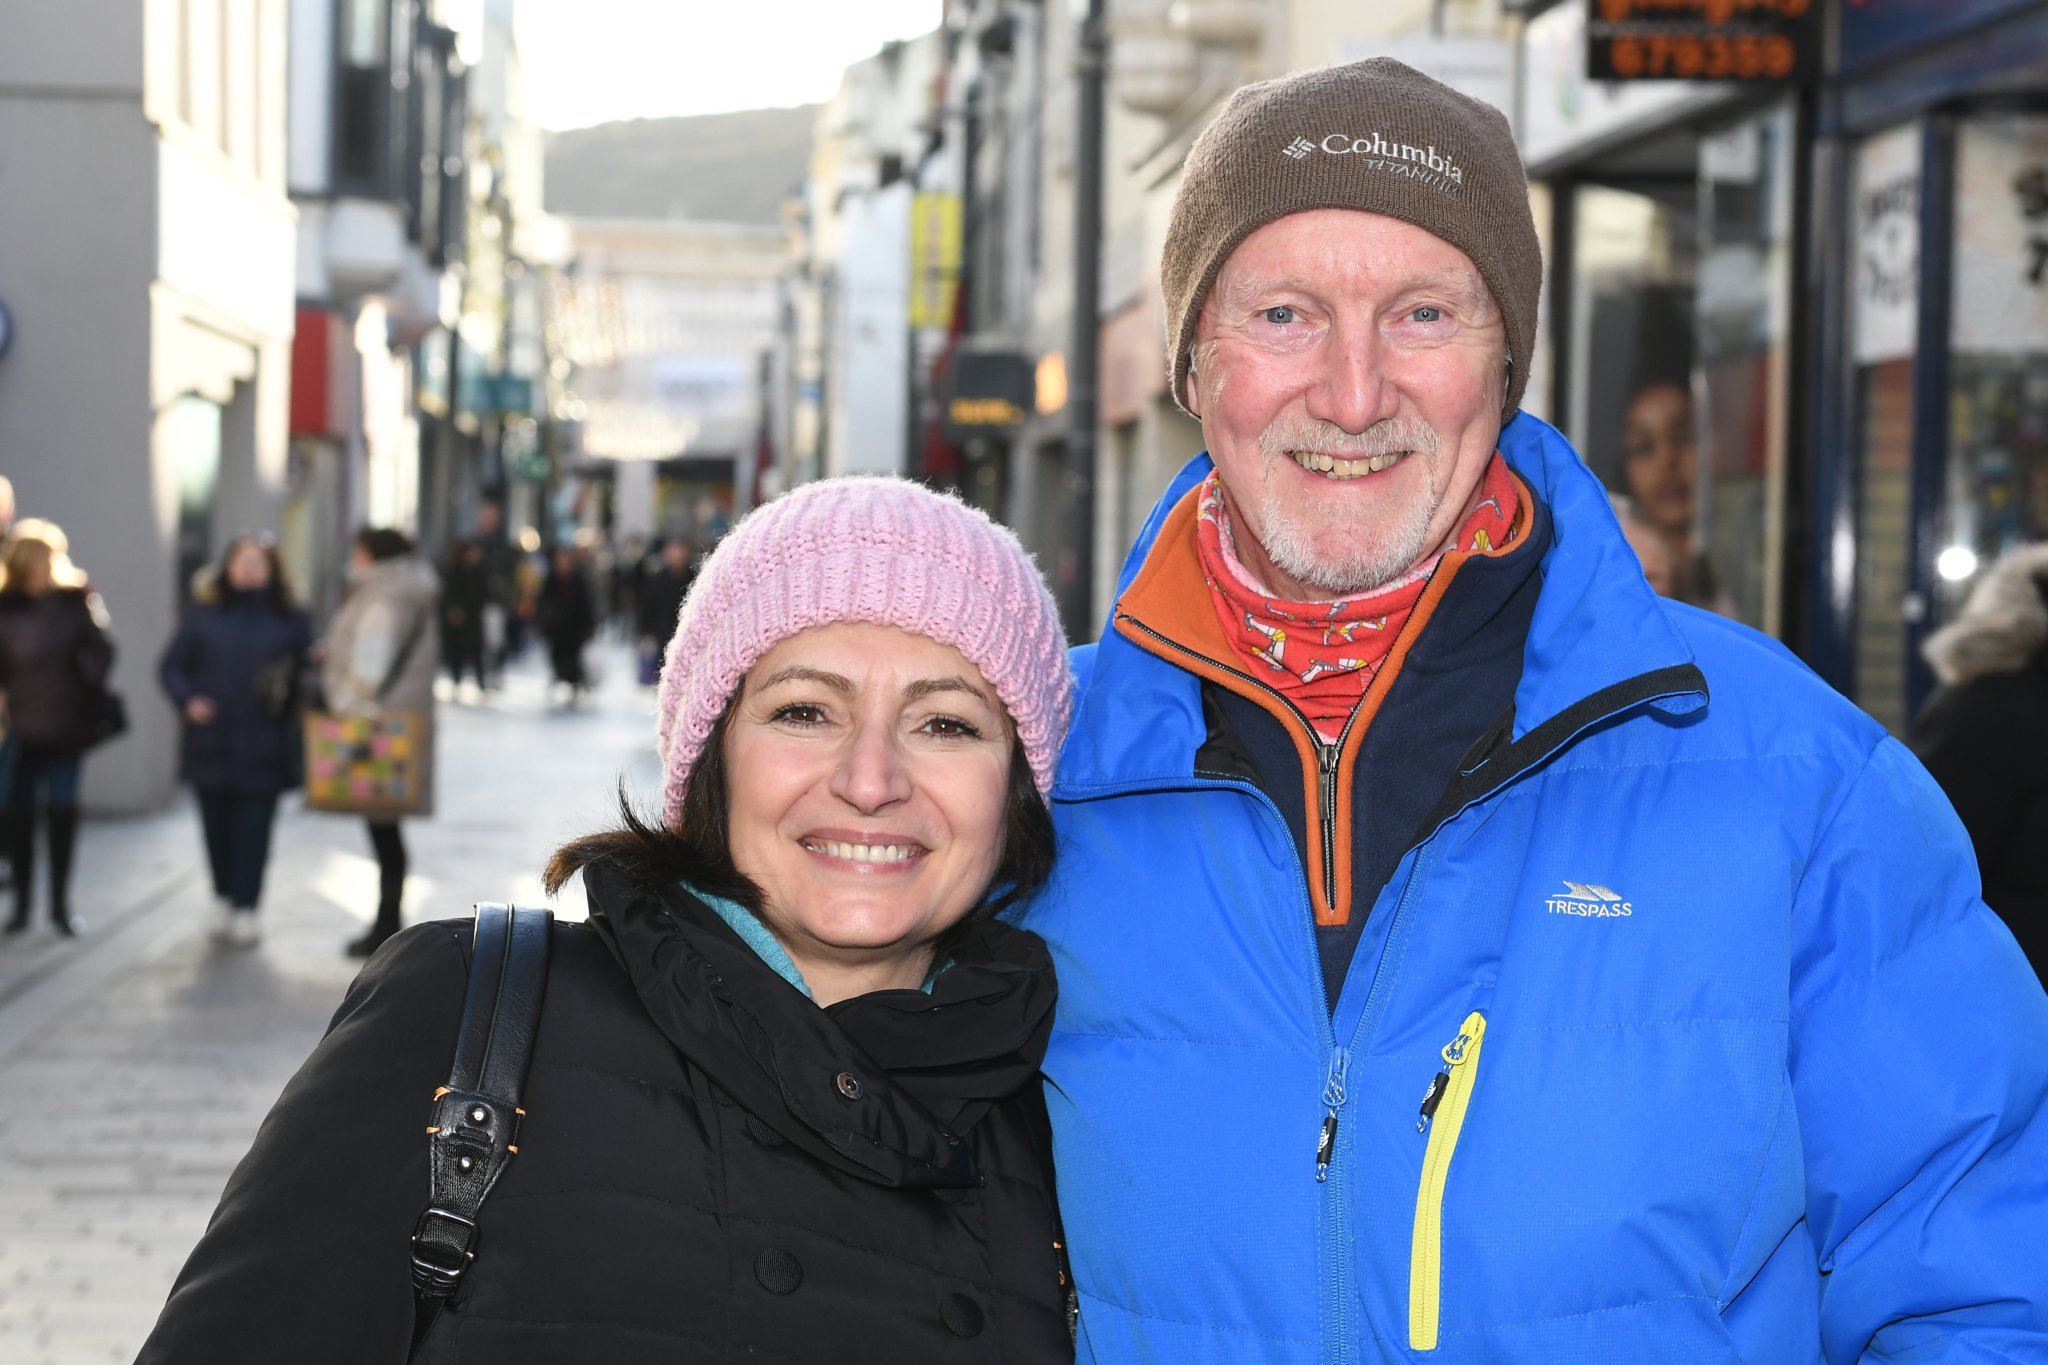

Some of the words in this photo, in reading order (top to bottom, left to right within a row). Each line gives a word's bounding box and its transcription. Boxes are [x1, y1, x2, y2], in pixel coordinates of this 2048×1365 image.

[1321, 133, 1462, 184] Columbia
[1363, 158, 1459, 198] TITANIUM
[1545, 900, 1632, 917] TRESPASS
